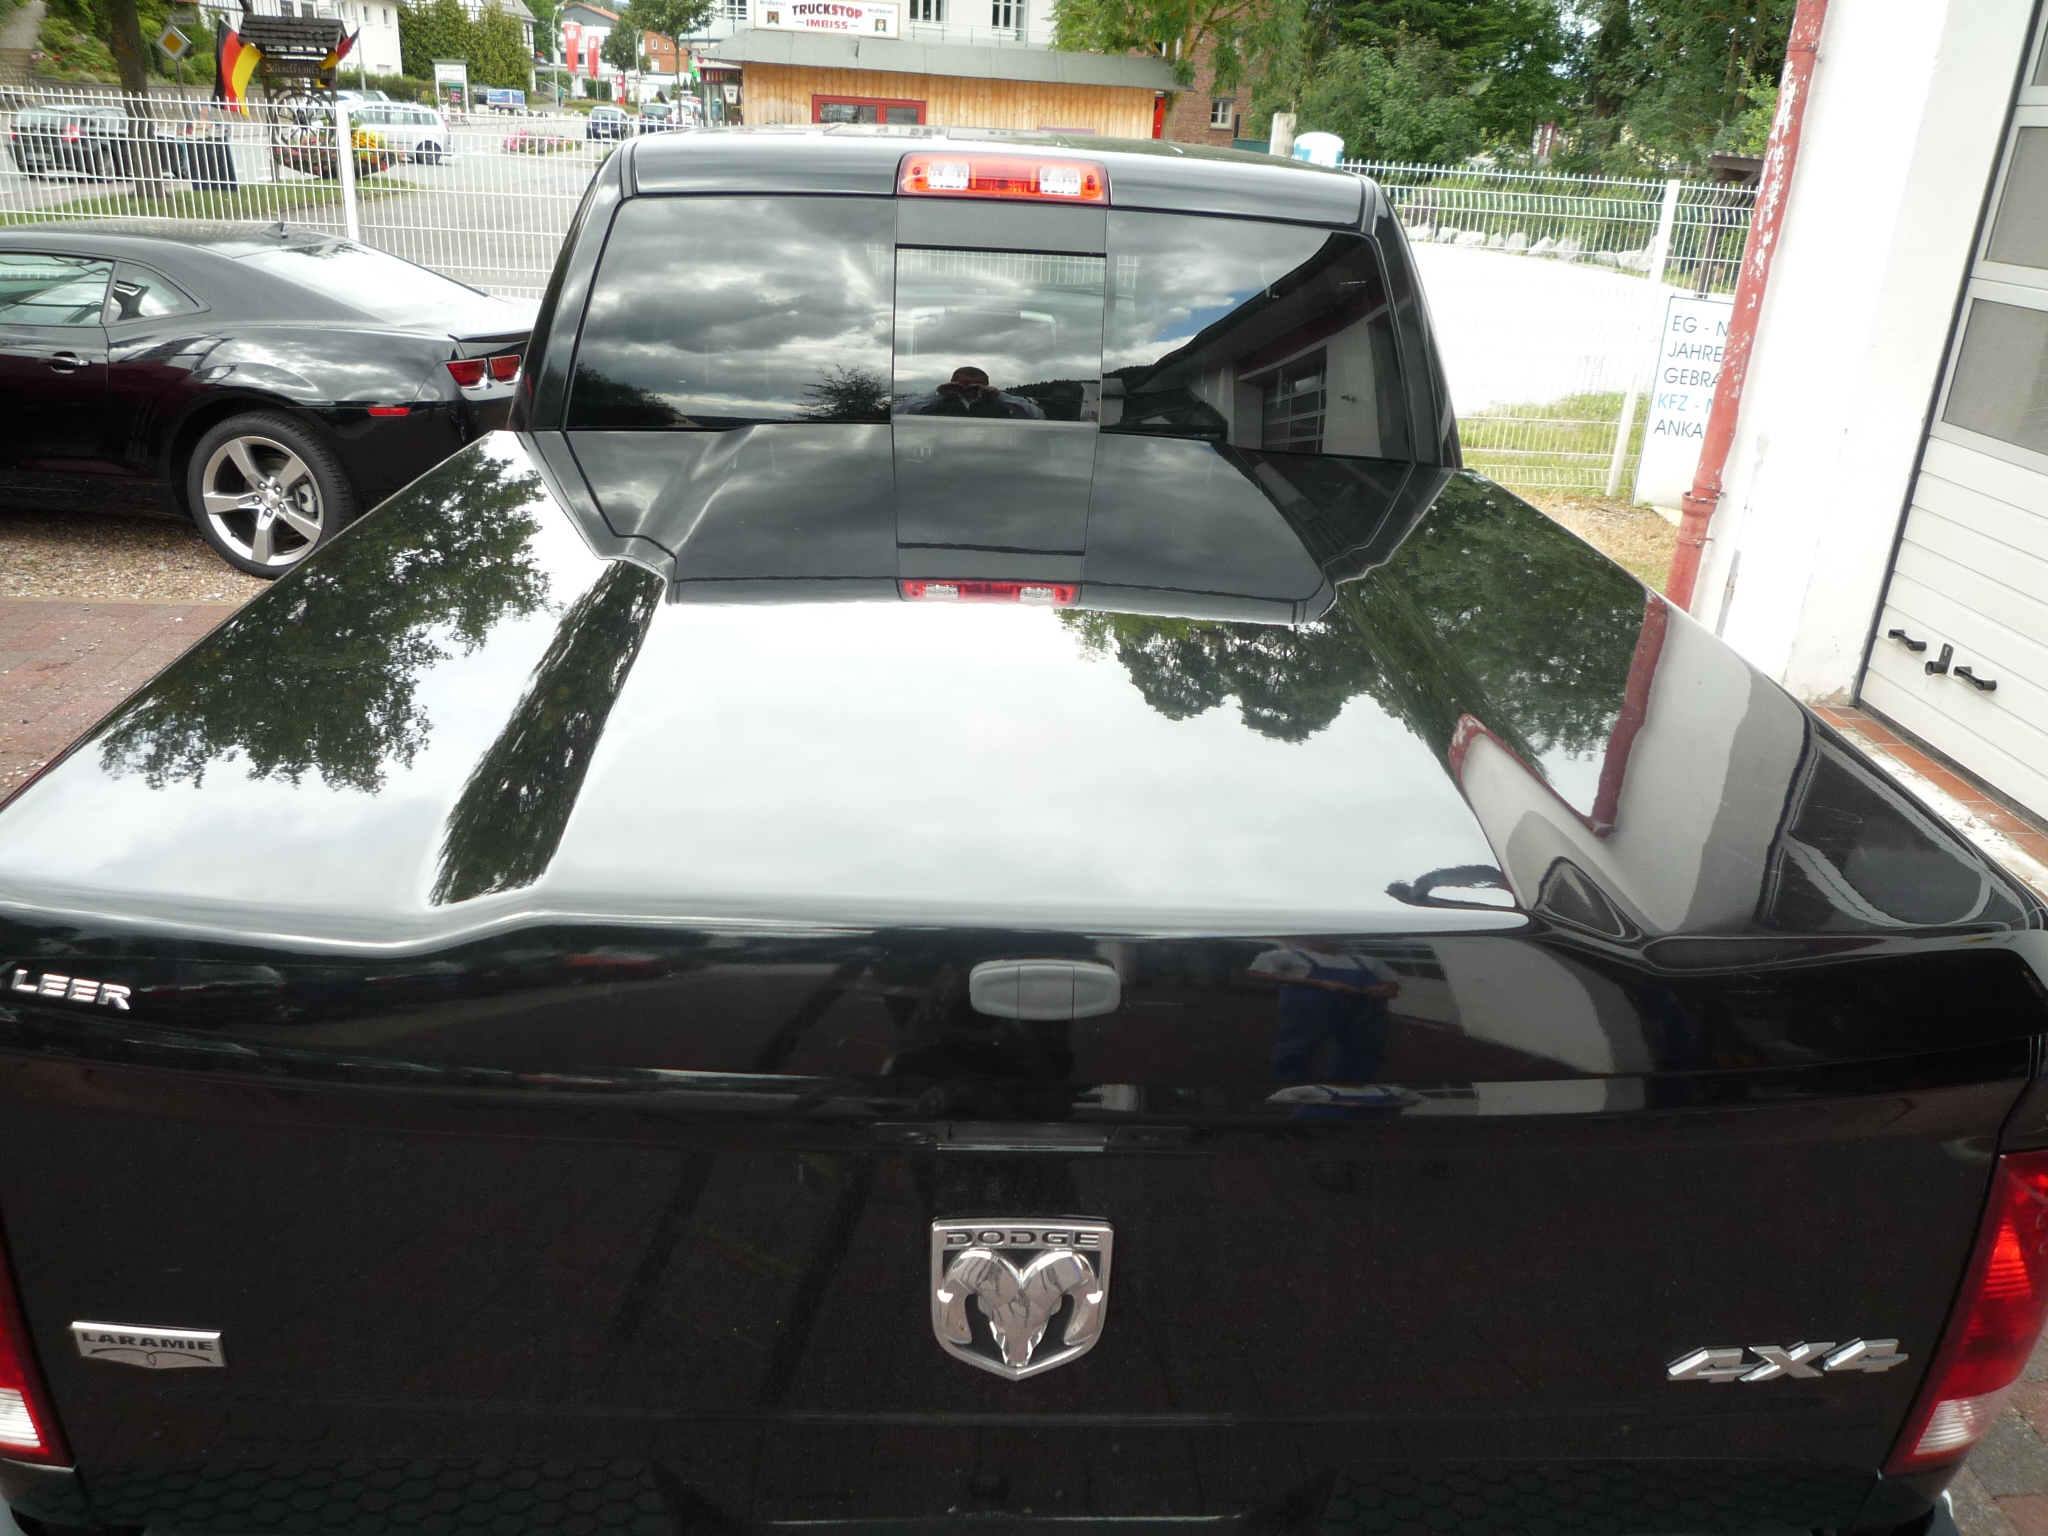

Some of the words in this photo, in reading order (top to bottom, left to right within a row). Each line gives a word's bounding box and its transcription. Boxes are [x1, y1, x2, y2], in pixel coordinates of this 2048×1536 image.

[792, 3, 863, 20] TRUCKSTOP
[805, 18, 849, 30] IMBISS
[1671, 315, 1698, 333] EG
[1667, 341, 1724, 363] JAHRE
[1657, 392, 1689, 412] KFZ
[1653, 418, 1704, 439] ANKA
[11, 968, 132, 1010] LEER
[946, 1230, 1100, 1248] DODGE
[81, 1331, 215, 1352] LARAMIE
